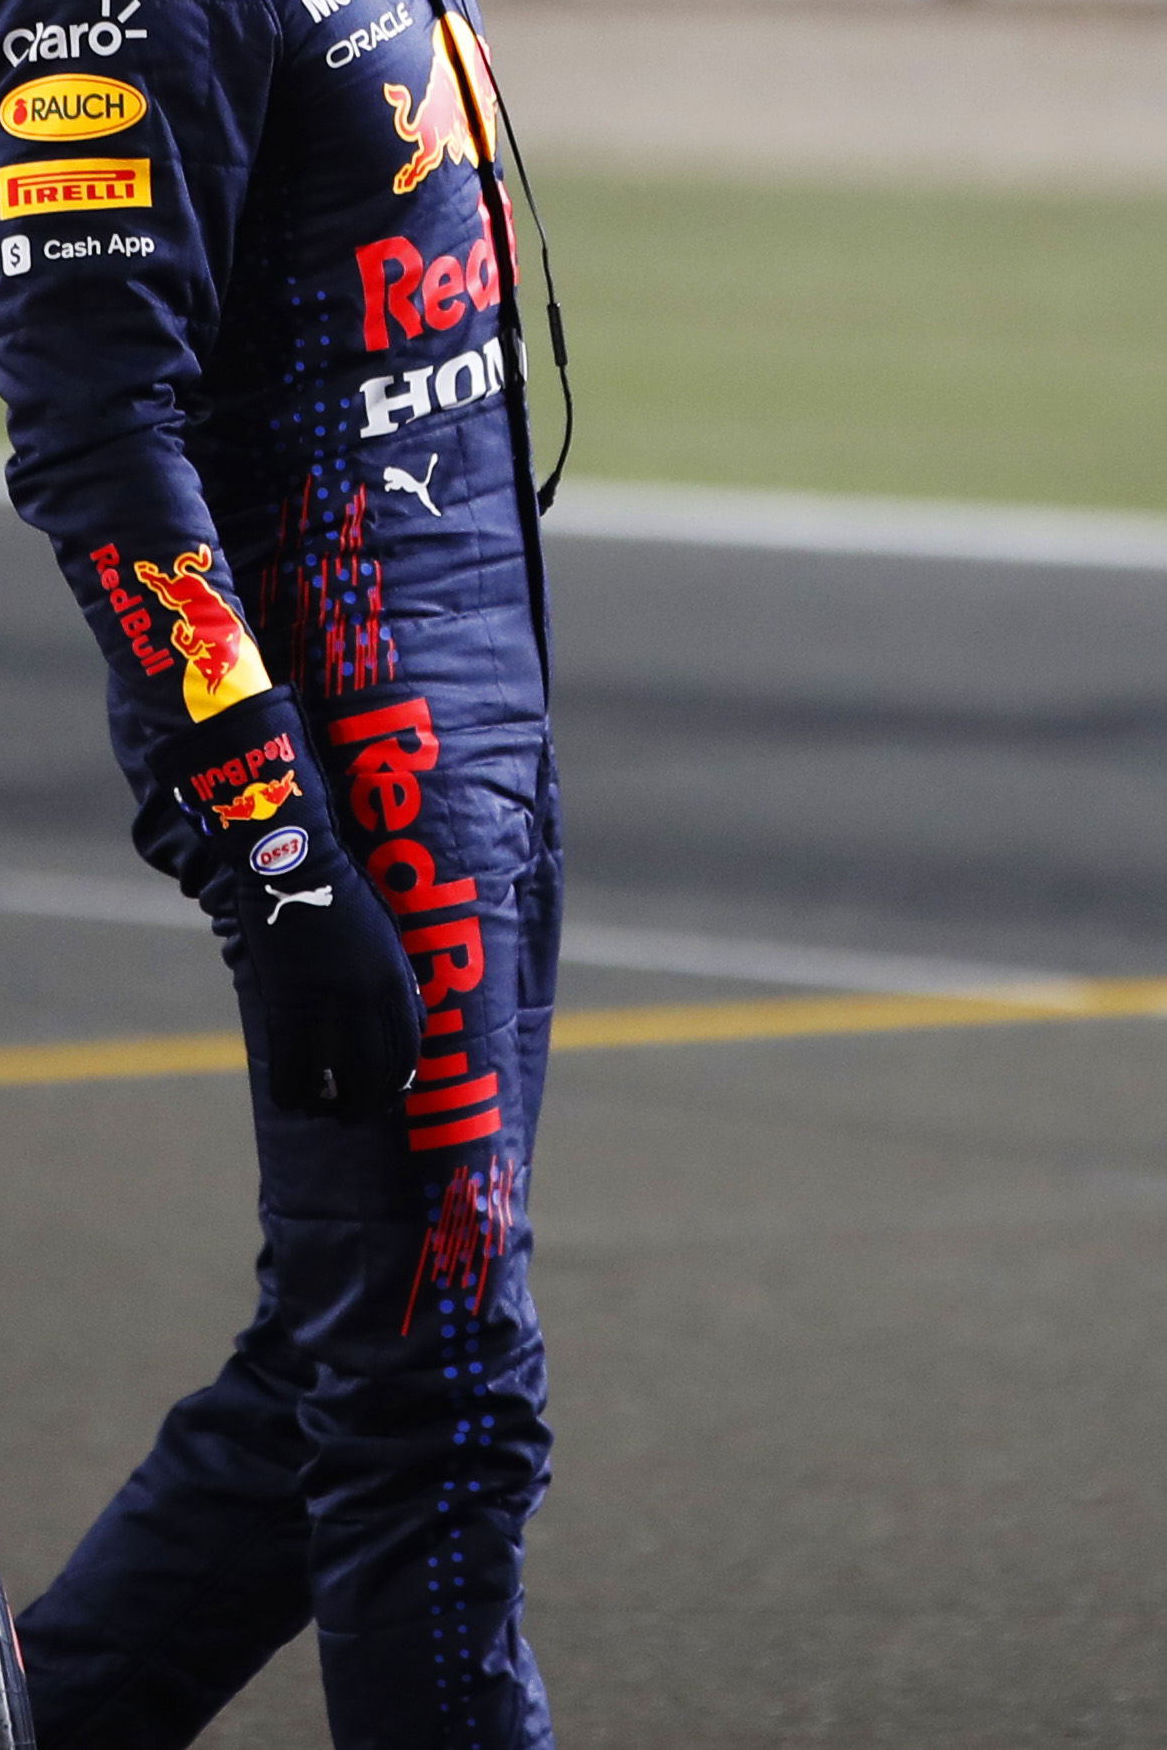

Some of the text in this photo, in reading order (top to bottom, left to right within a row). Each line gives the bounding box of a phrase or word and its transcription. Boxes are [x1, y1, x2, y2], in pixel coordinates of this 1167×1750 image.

[326, 2, 414, 68] ORACLE
[31, 93, 125, 121] RAUCH
[7, 170, 136, 207] PIRELLI
[44, 236, 101, 260] Cash
[108, 234, 155, 257] App
[355, 190, 501, 352] Red
[90, 543, 174, 676] Red Bull
[327, 697, 478, 916] Red
